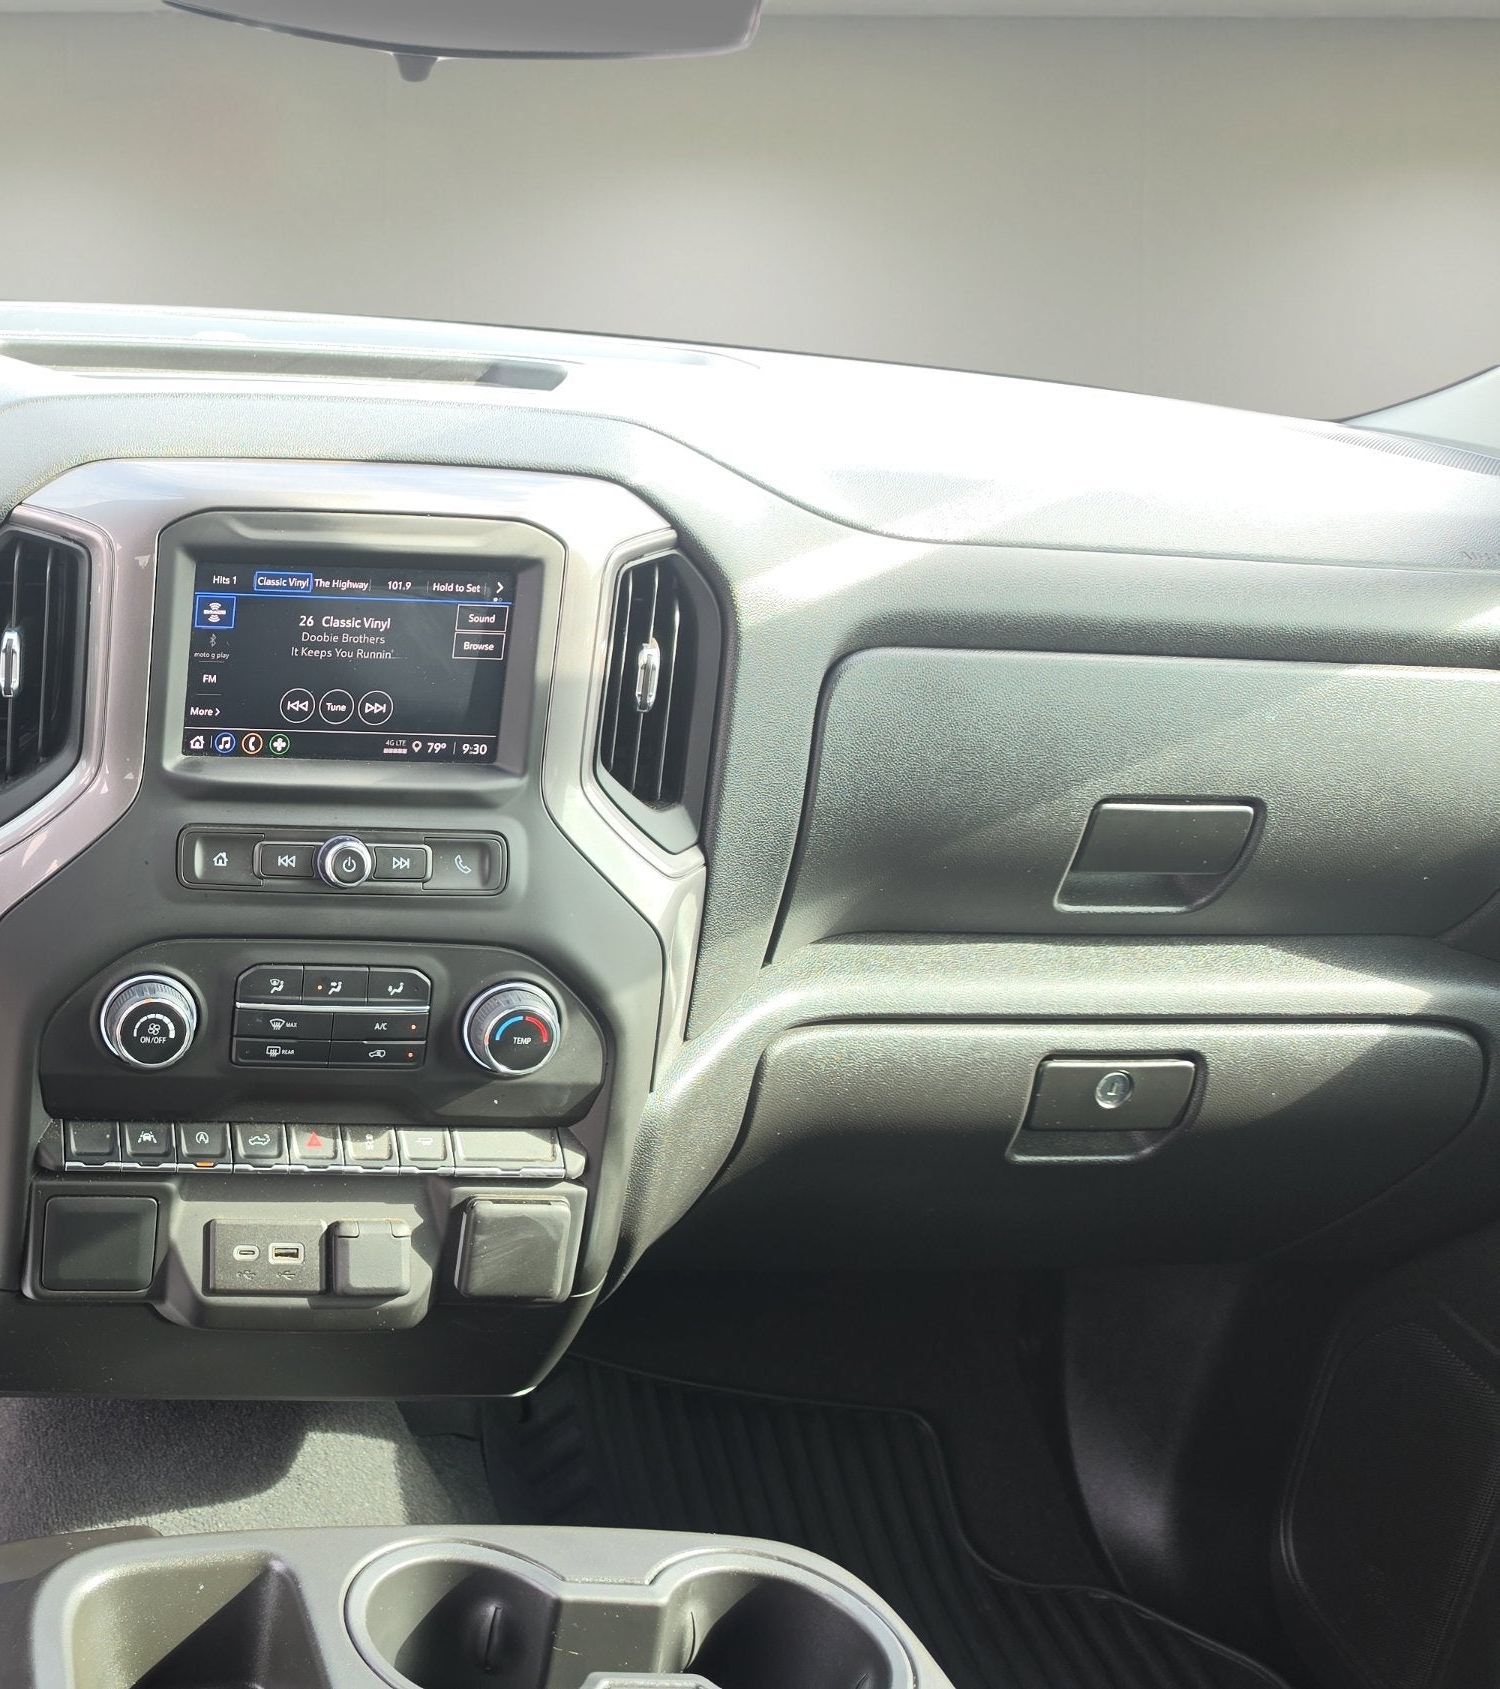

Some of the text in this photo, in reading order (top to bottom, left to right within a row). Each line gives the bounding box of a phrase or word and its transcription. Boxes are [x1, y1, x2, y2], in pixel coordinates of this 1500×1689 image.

[212, 575, 231, 585] Hits
[257, 576, 287, 588] Classic
[289, 578, 310, 590] Vinyl
[314, 578, 331, 588] The
[331, 579, 369, 591] Highway
[387, 581, 412, 591] 101.9
[432, 583, 454, 593] Hold
[455, 585, 465, 593] to
[466, 584, 481, 593] Set
[299, 615, 391, 632] 26 Classic Vinyl
[468, 614, 496, 624] Sound
[301, 631, 386, 645] Doobie Brothers
[463, 641, 495, 651] Browse
[216, 652, 230, 660] play
[291, 647, 299, 657] It
[300, 647, 333, 660] Keeps
[334, 648, 354, 658] You
[202, 674, 217, 684] FM
[189, 706, 214, 717] More
[325, 702, 347, 712] Tune
[385, 739, 395, 747] 4G
[395, 739, 407, 747] LTE
[462, 743, 488, 755] 9:30
[374, 1023, 388, 1031] A/C
[140, 1036, 167, 1044] ON/OFF
[513, 1036, 532, 1045] TEMP
